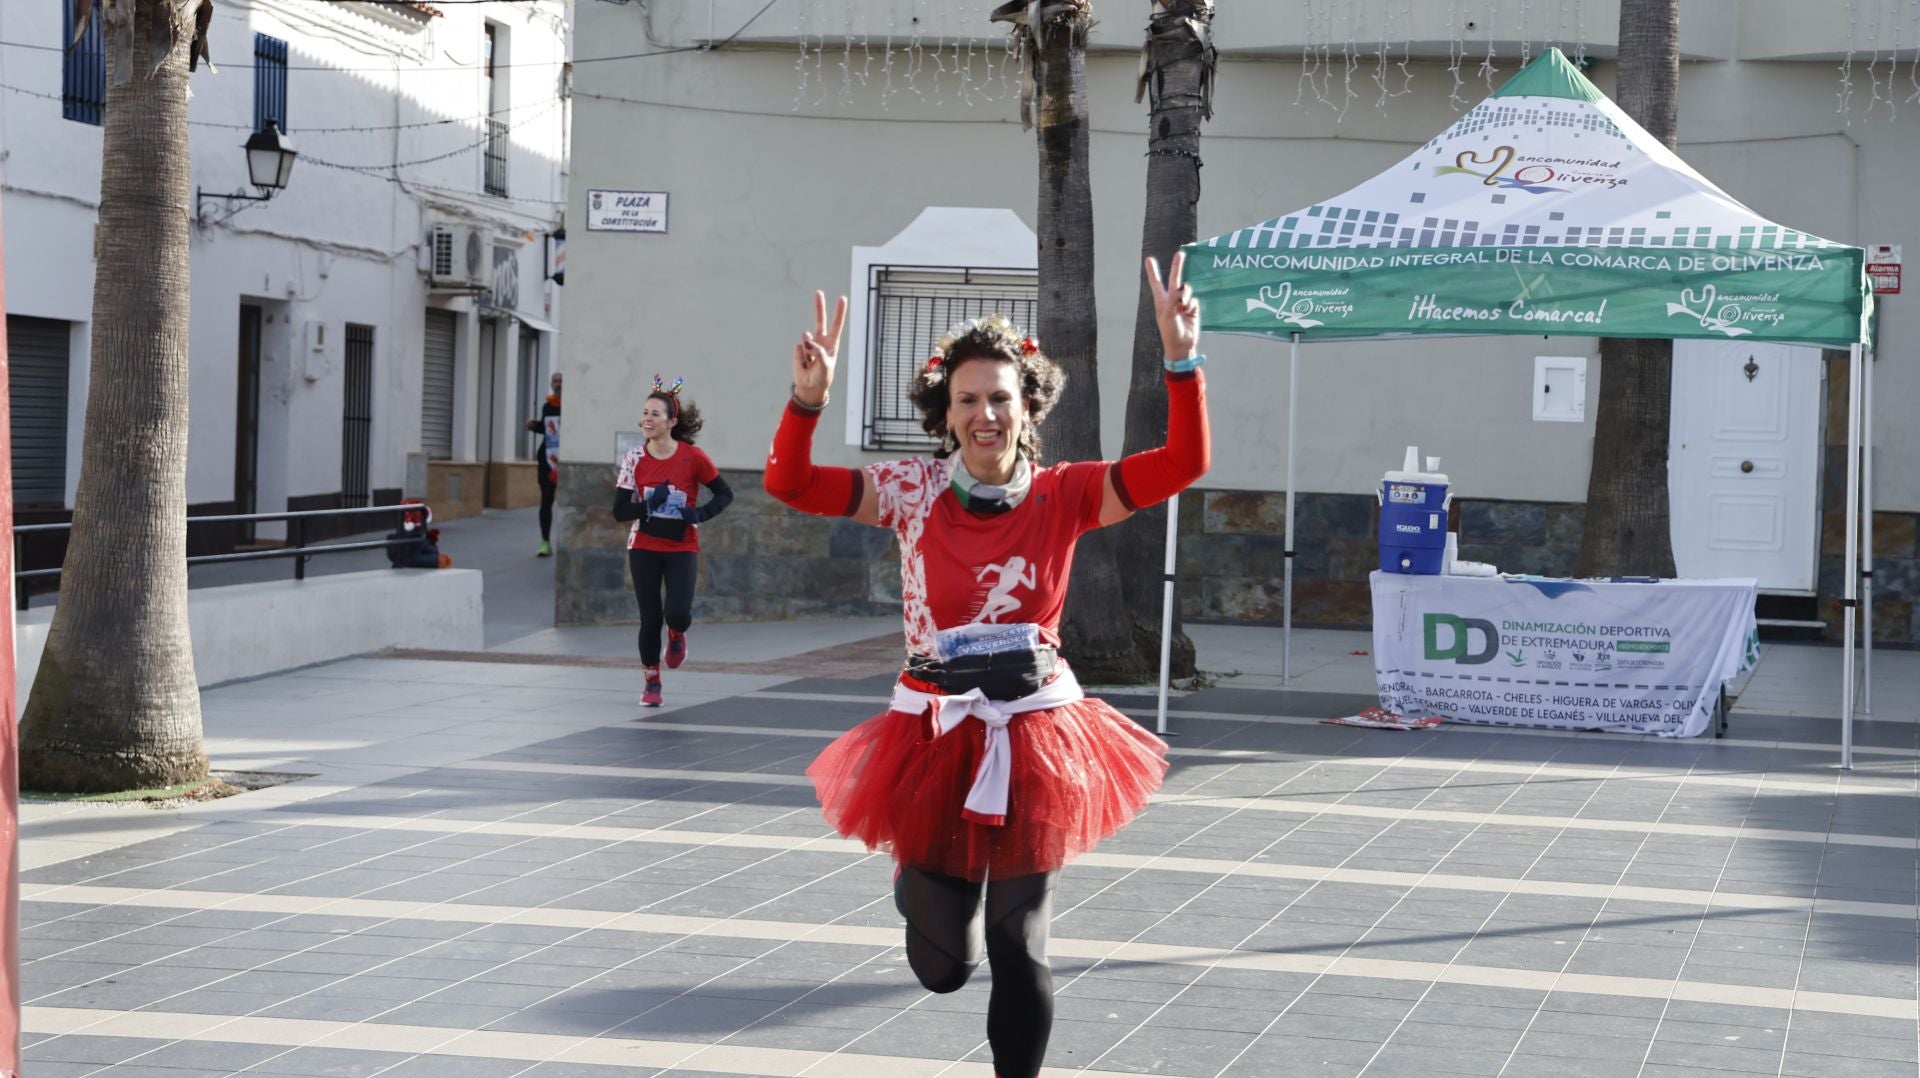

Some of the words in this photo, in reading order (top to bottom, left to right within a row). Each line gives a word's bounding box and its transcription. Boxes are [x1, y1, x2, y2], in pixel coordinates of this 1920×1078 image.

[1515, 165, 1628, 189] Olivenza
[615, 196, 650, 207] PLAZA
[1212, 253, 1384, 270] MANCOMUNIDAD
[1389, 250, 1490, 267] INTEGRAL
[1496, 249, 1521, 263] DE
[1528, 252, 1554, 264] LA
[1561, 253, 1671, 271] COMARCA
[1678, 255, 1705, 271] DE
[1712, 254, 1824, 271] OLIVENZA
[1869, 264, 1900, 272] Alarma
[1408, 294, 1502, 320] ¡Hacemos
[1508, 299, 1607, 324] Comarca!
[1396, 524, 1421, 532] IGLOO
[1502, 620, 1596, 635] DINAMIZACIÓN
[1600, 626, 1671, 638] DEPORTIVA
[1501, 635, 1518, 646] DE
[1521, 636, 1615, 651] EXTREMADURA
[1426, 687, 1493, 700] BARCARROTA
[1504, 692, 1542, 704] CHELES
[1553, 696, 1599, 707] HIGUERA
[1602, 698, 1616, 708] DE
[1620, 699, 1662, 709] VARGAS
[1468, 704, 1518, 717] VALVERDE
[1521, 708, 1534, 718] DE
[1537, 709, 1585, 721] LEGANÉS
[1595, 712, 1660, 724] VILLANUEVA
[1664, 714, 1683, 724] DEL
